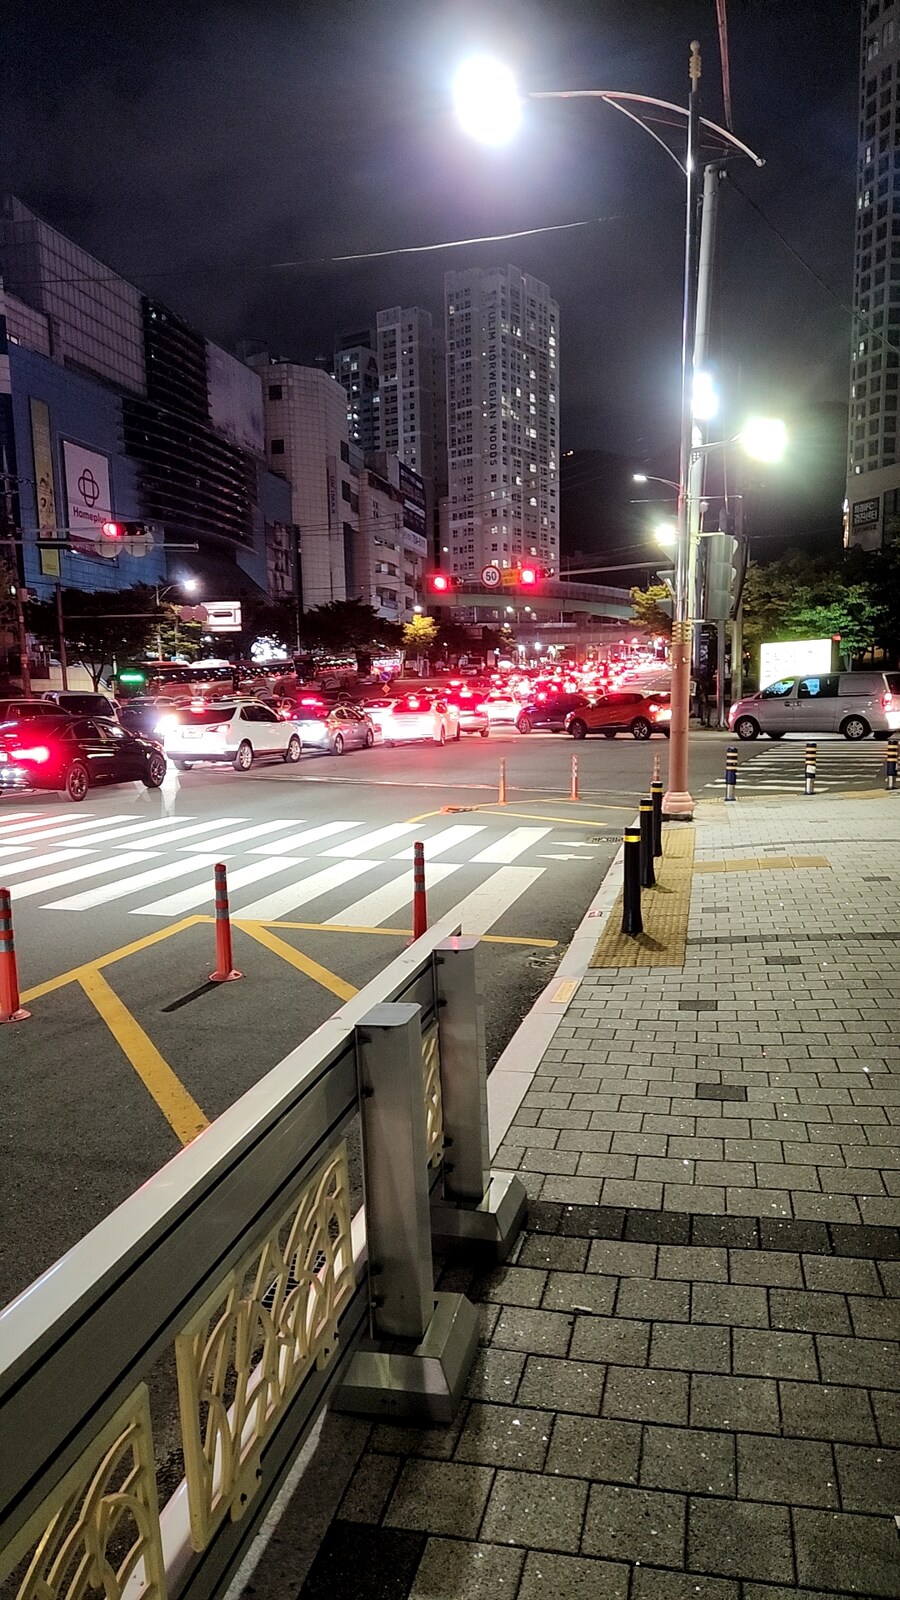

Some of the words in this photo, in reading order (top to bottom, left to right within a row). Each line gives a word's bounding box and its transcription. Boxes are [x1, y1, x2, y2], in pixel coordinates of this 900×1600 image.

[488, 302, 496, 340] YULIM
[488, 345, 497, 419] NORWEGIAN
[489, 424, 498, 466] WOODS
[485, 571, 497, 581] 50
